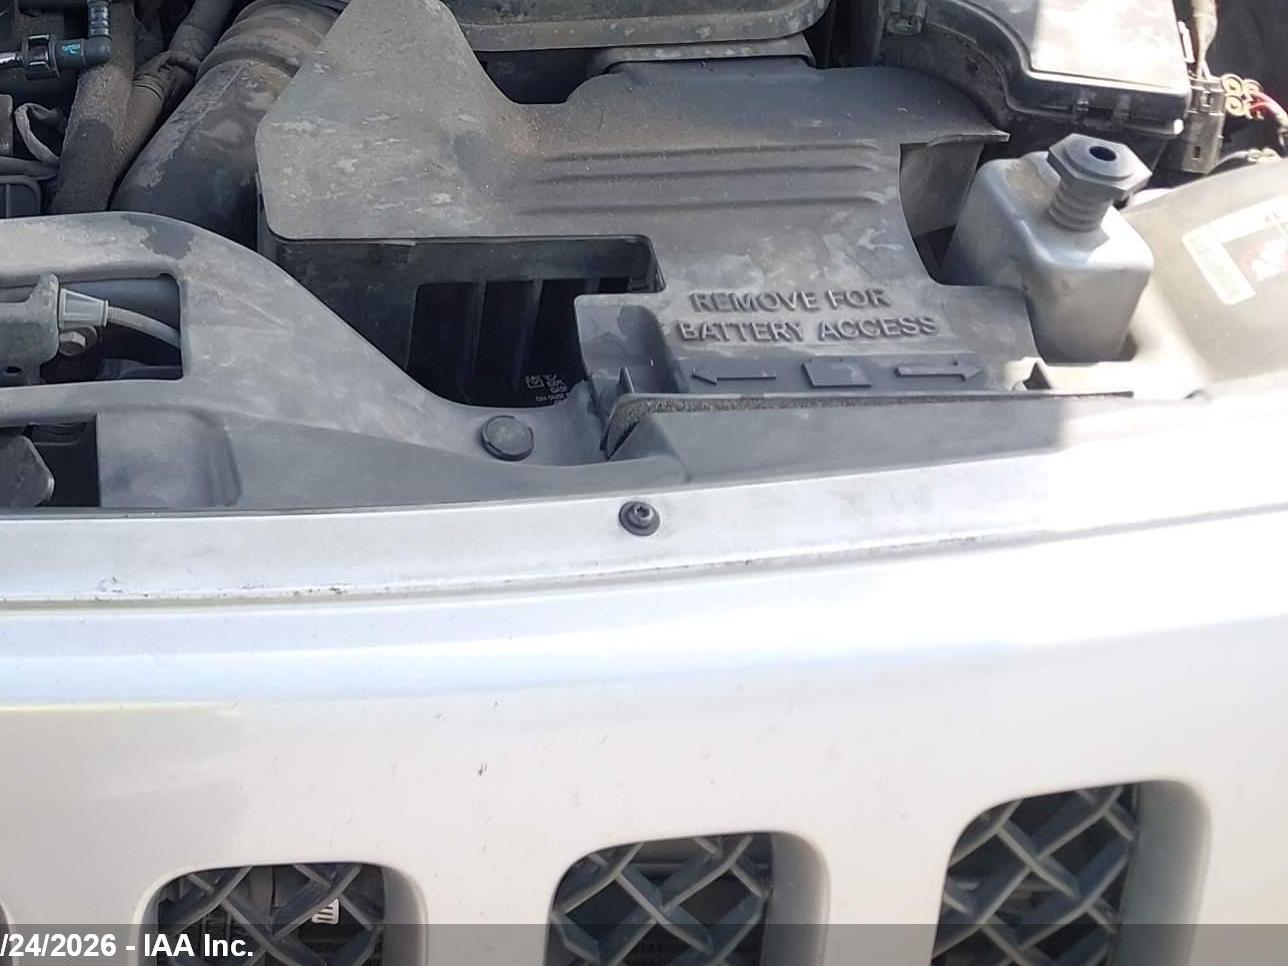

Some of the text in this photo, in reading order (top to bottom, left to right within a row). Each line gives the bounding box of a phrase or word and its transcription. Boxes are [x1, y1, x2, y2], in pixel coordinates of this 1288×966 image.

[689, 289, 892, 313] REMOVE FOR
[675, 316, 937, 342] BATTERY ACCESS
